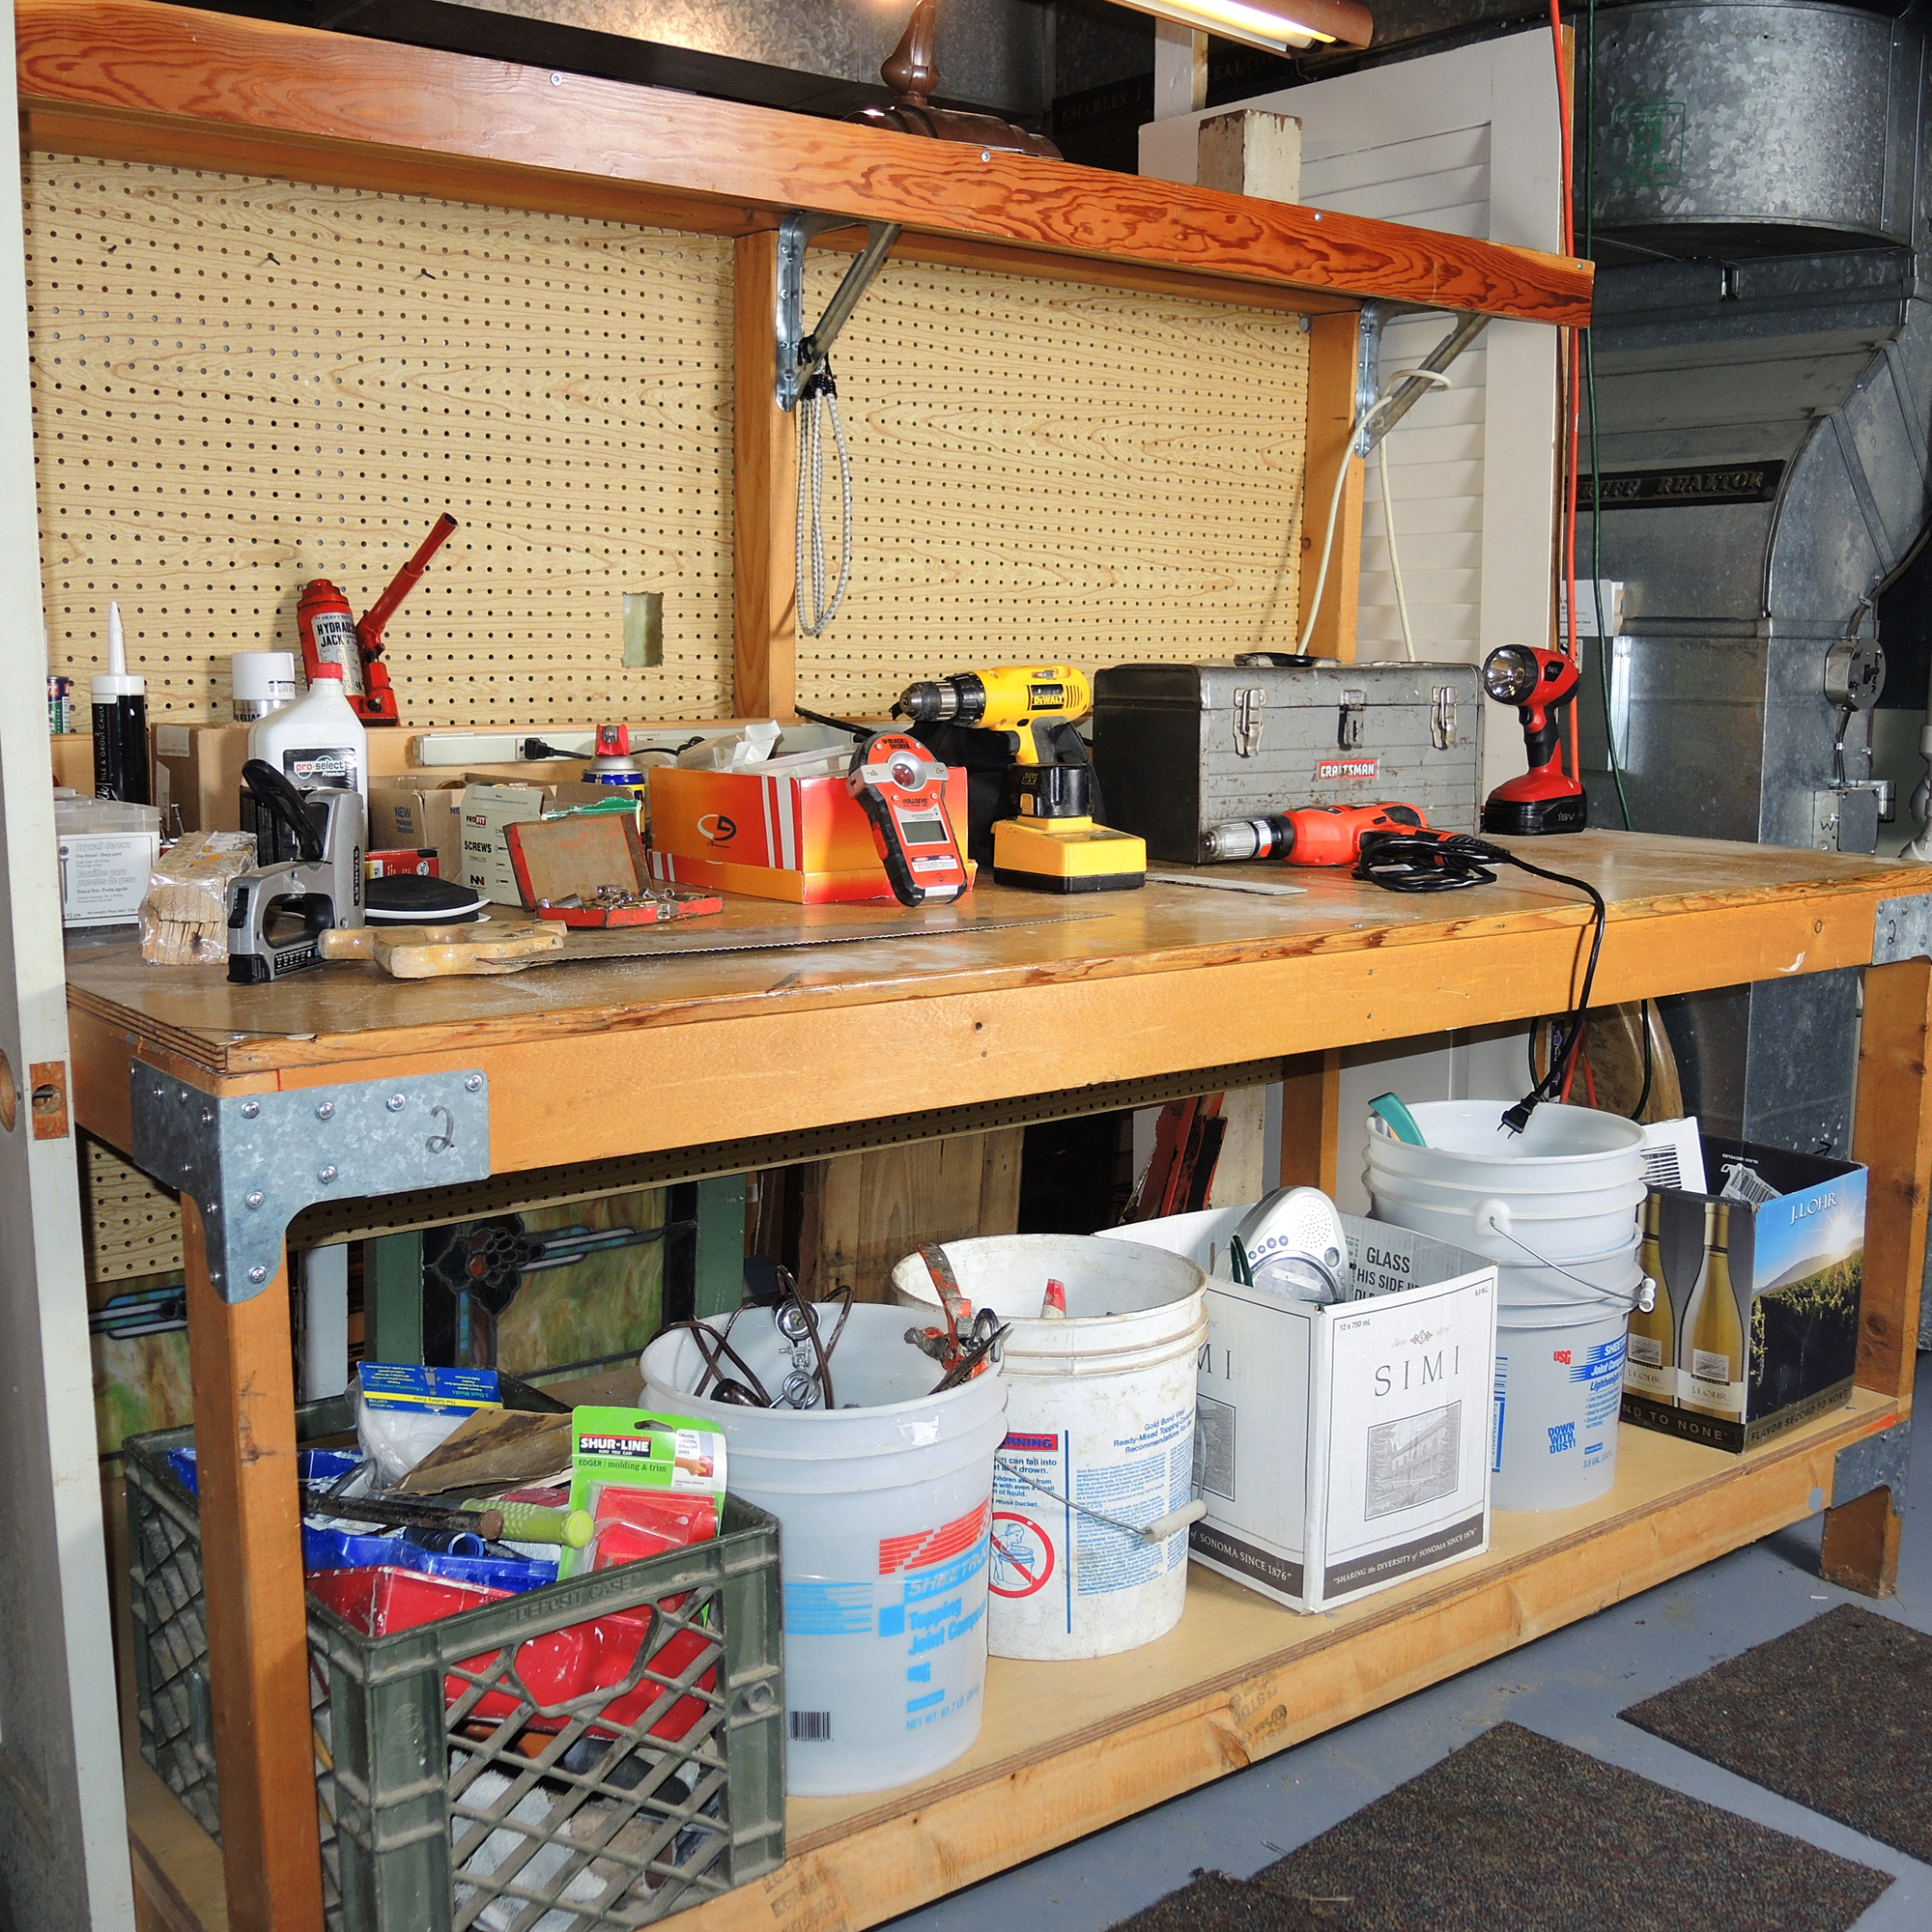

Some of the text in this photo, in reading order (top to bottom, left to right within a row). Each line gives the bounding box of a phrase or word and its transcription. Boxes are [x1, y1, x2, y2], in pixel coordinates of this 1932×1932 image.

[1064, 91, 1127, 122] CHARLES
[1657, 472, 1764, 495] REALTOR
[321, 635, 344, 647] JACK
[395, 807, 412, 818] NEW
[1558, 811, 1575, 821] 18V
[1820, 820, 1834, 831] W
[75, 840, 131, 853] Drywall Screws
[465, 840, 492, 853] SCREWS
[1367, 1246, 1410, 1273] GLASS
[1357, 1268, 1405, 1293] HIS SIDE
[1198, 1343, 1233, 1380] MI
[1553, 1350, 1572, 1365] USG
[1374, 1345, 1461, 1397] SIMI
[1590, 1362, 1608, 1376] Joint
[1145, 1420, 1159, 1431] Gold
[1160, 1413, 1175, 1425] Bond
[1650, 1411, 1668, 1424] TO
[1751, 1421, 1783, 1442] FLAVOR
[1784, 1406, 1816, 1428] SECOND
[1817, 1402, 1829, 1413] TO
[1114, 1430, 1158, 1447] Ready-Mixed
[1159, 1421, 1179, 1435] Topping
[1548, 1421, 1575, 1436] DOWN
[1005, 1436, 1053, 1448] RNING
[1125, 1430, 1179, 1453] Recommendations
[1549, 1438, 1577, 1454] DUST!
[1550, 1432, 1574, 1445] WITH
[608, 1461, 639, 1471] molding
[649, 1463, 667, 1472] trim
[1200, 1533, 1237, 1558] SONOMA
[1239, 1551, 1266, 1571] SINCE
[1377, 1555, 1410, 1571] DIVERSITY
[1419, 1543, 1446, 1557] SONOMA
[1447, 1534, 1463, 1547] SINCE
[909, 1598, 962, 1632] Topping
[908, 1627, 946, 1656] Joint
[906, 1718, 922, 1731] NET
